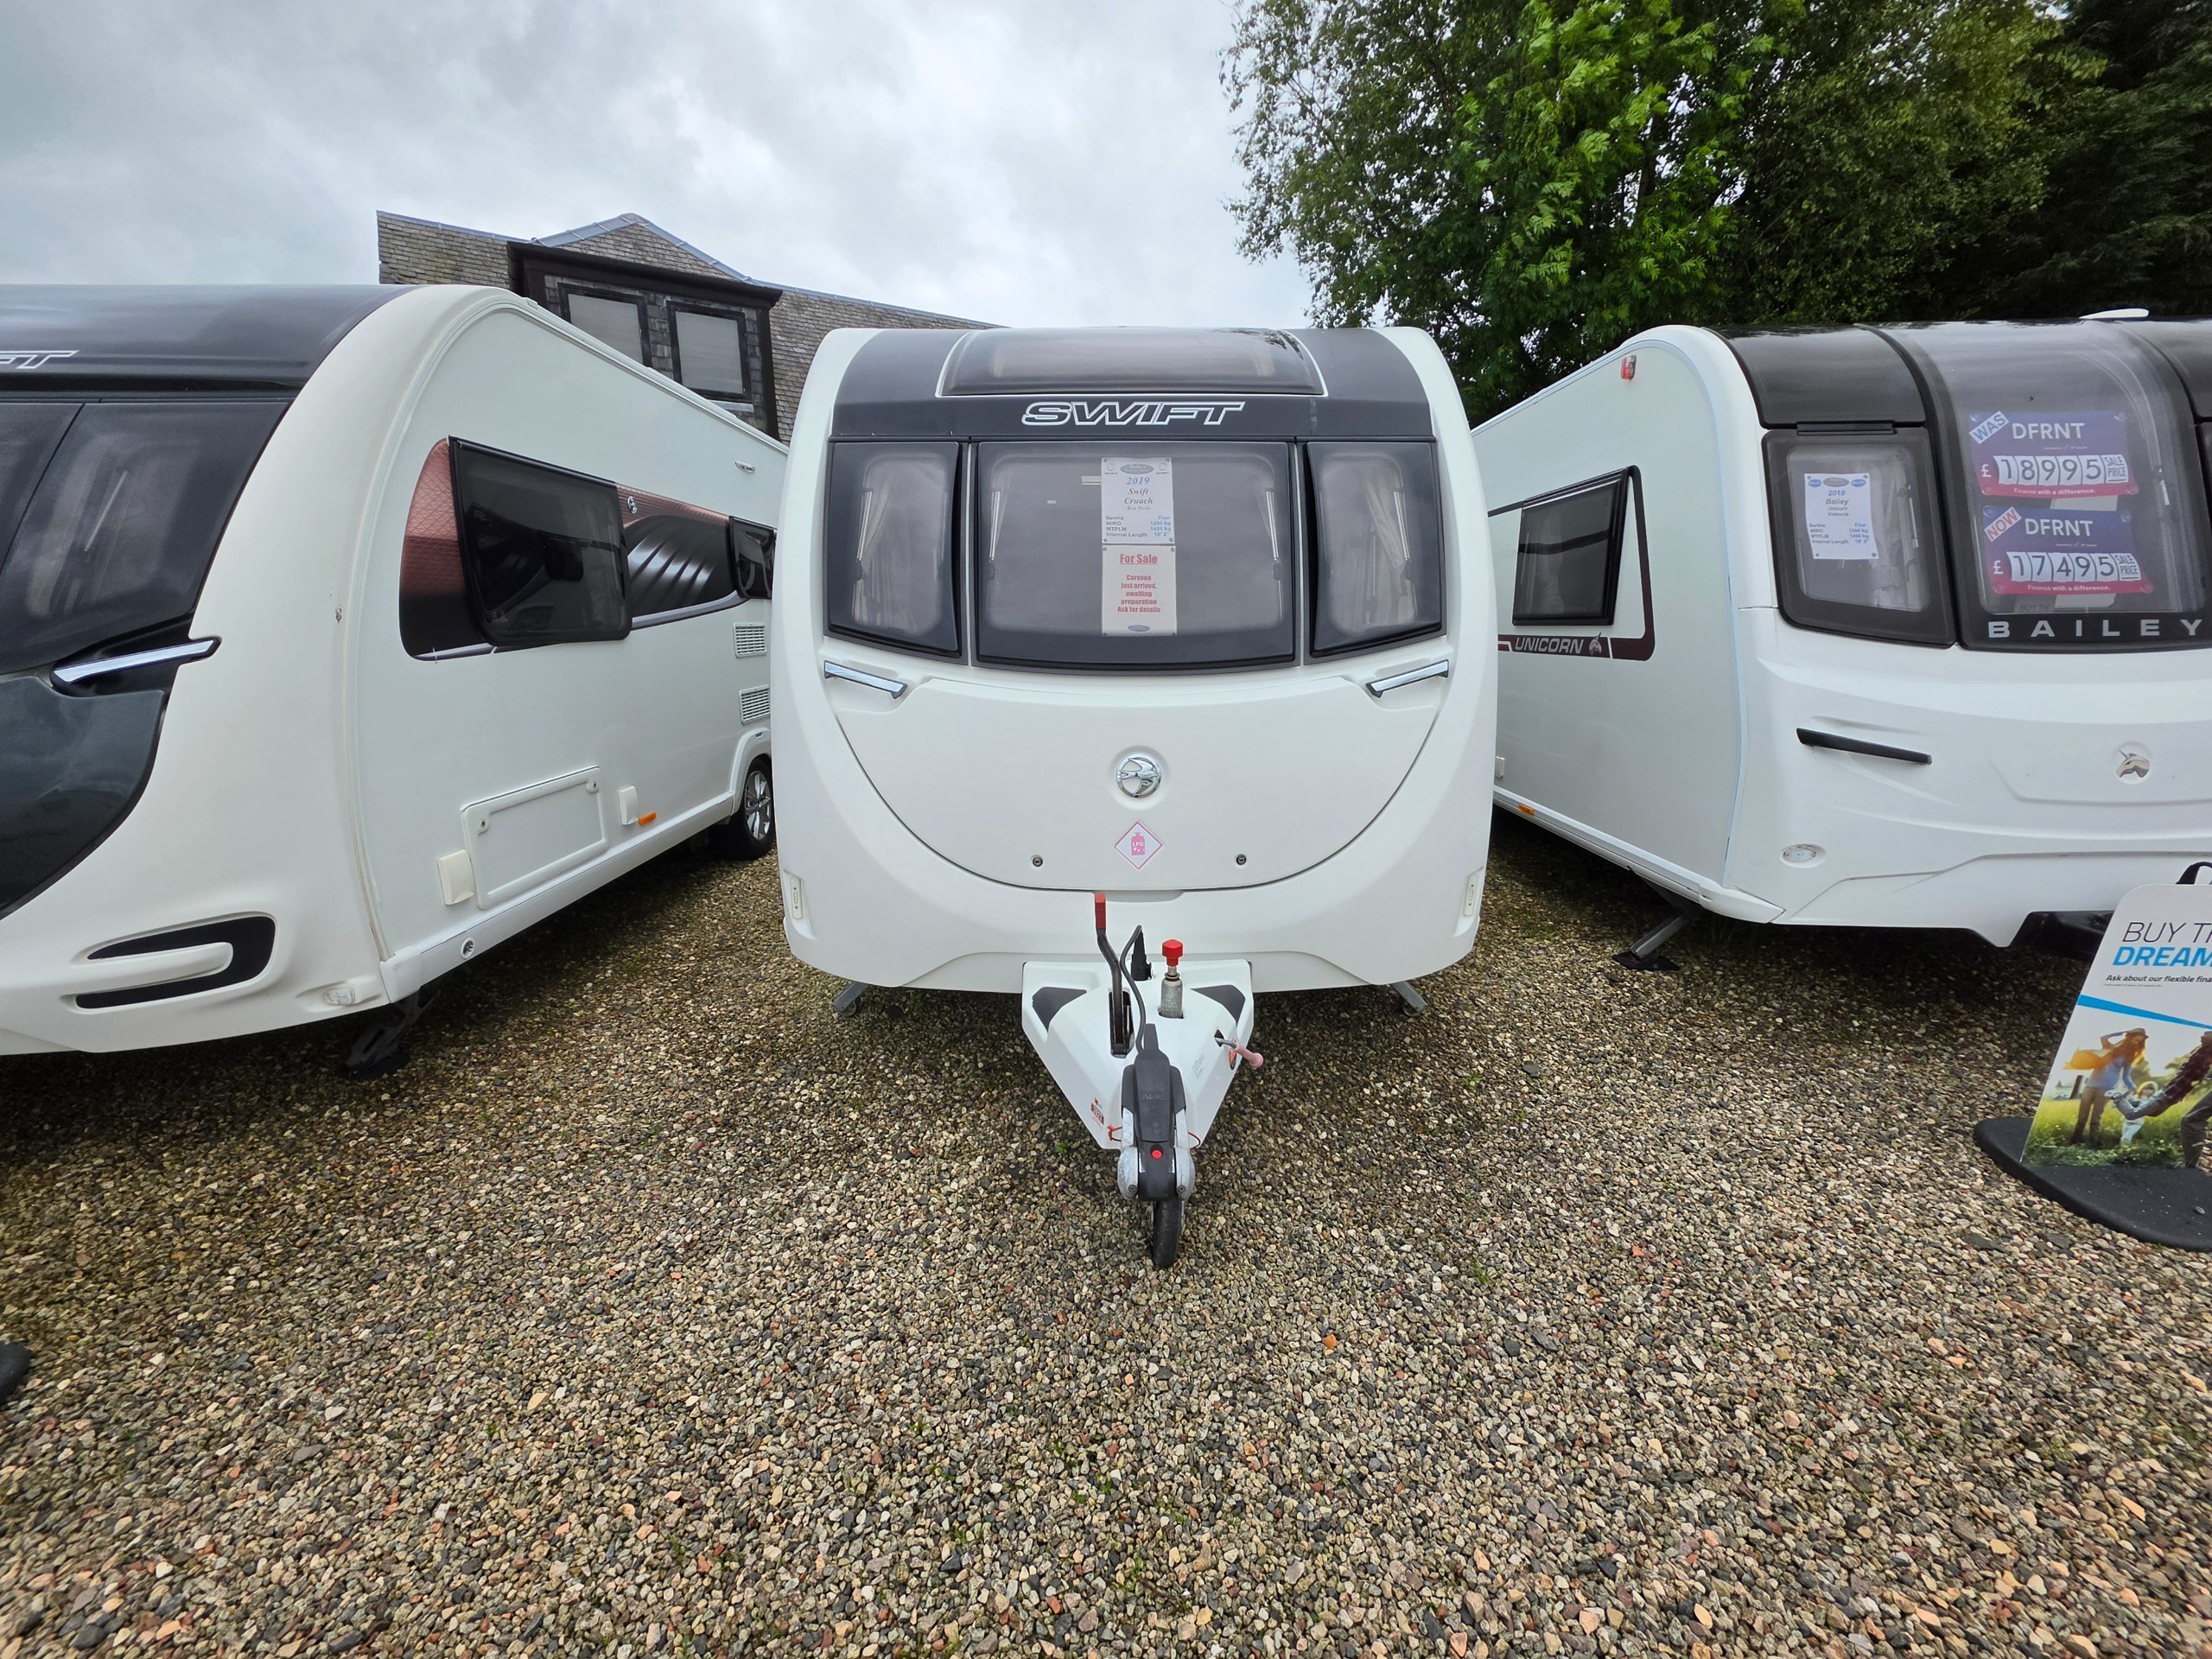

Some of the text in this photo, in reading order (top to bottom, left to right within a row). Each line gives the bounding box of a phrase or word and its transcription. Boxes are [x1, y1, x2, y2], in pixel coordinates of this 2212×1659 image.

[1021, 401, 1246, 426] SWIFT
[1974, 413, 2005, 442] WAS
[2012, 423, 2085, 439] DFRNT
[1981, 459, 2101, 480] £ 18995
[2104, 456, 2125, 467] SALE
[2107, 467, 2126, 477] PRICE
[1986, 509, 2018, 540] NOW
[2024, 518, 2093, 536] DFRNT
[1120, 554, 1158, 563] For Sale
[1993, 556, 2114, 577] £ 17495
[2114, 555, 2135, 564] SALE
[2120, 564, 2139, 575] PRICE
[1987, 620, 2202, 638] BAILEY
[1515, 637, 1584, 654] UNICORN
[2122, 922, 2212, 943] BUY T
[2113, 946, 2212, 967] DREAM
